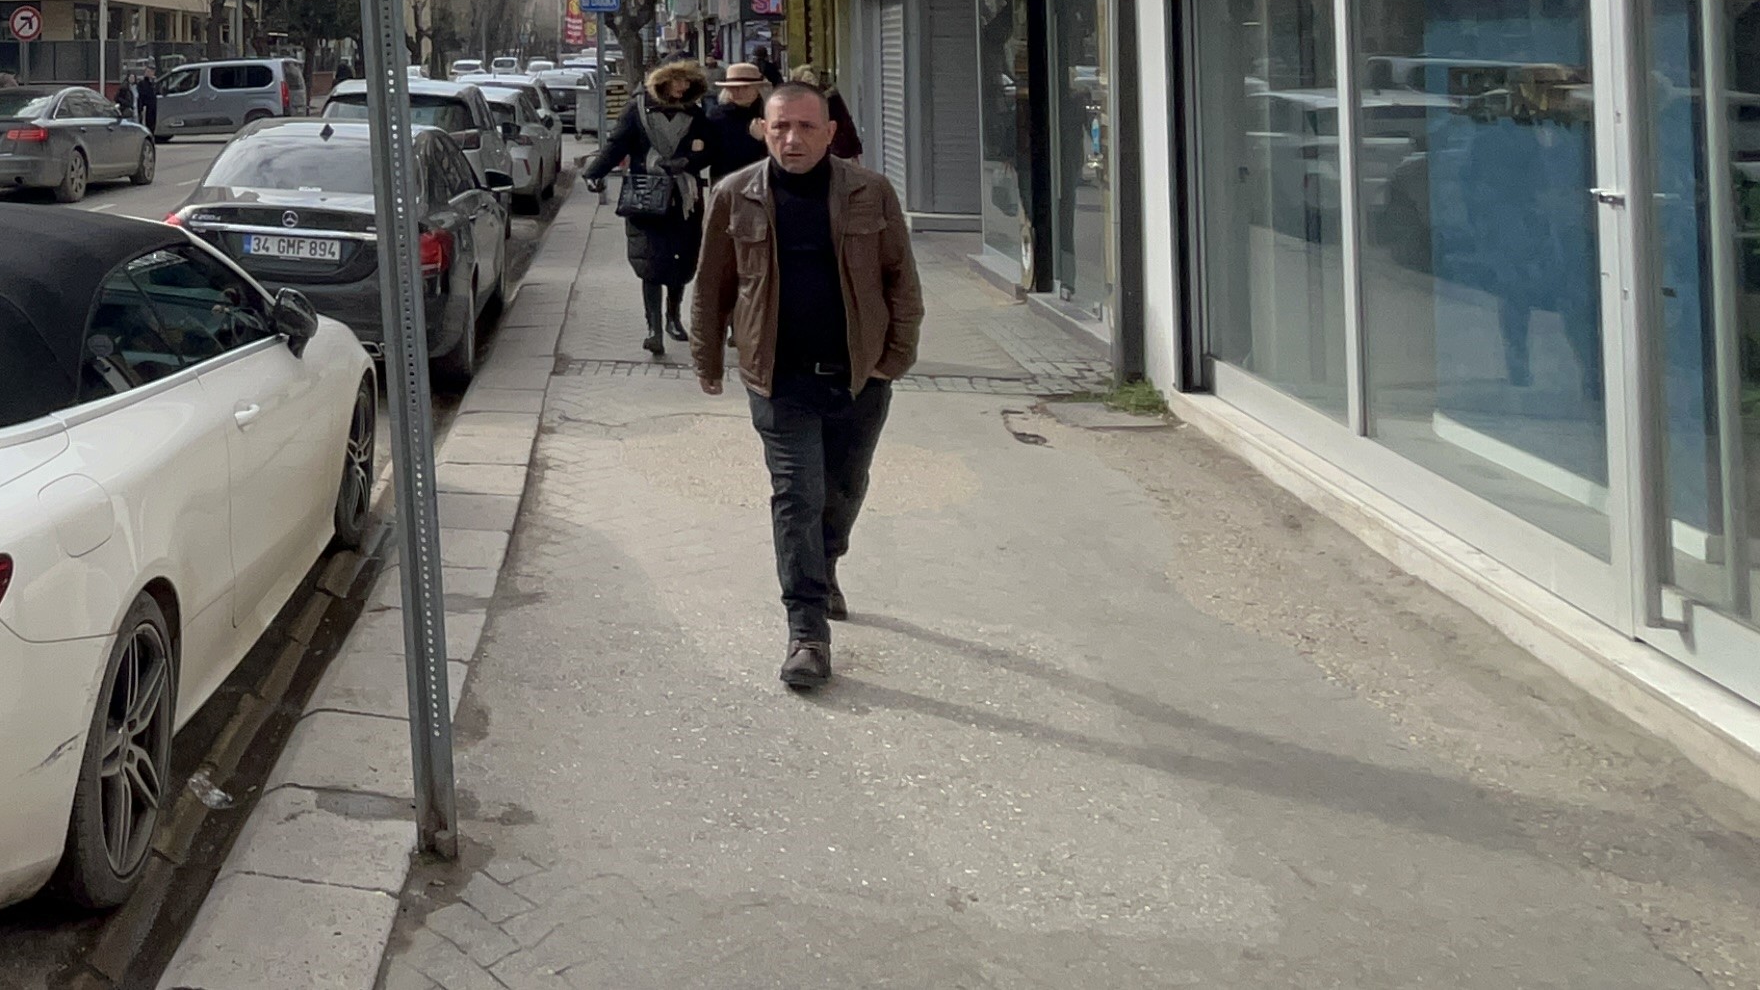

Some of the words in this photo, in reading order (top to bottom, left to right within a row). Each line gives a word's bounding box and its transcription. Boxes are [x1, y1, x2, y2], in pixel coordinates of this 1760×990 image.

[252, 237, 270, 253] 34
[277, 239, 305, 255] GMF
[308, 241, 337, 258] 894
